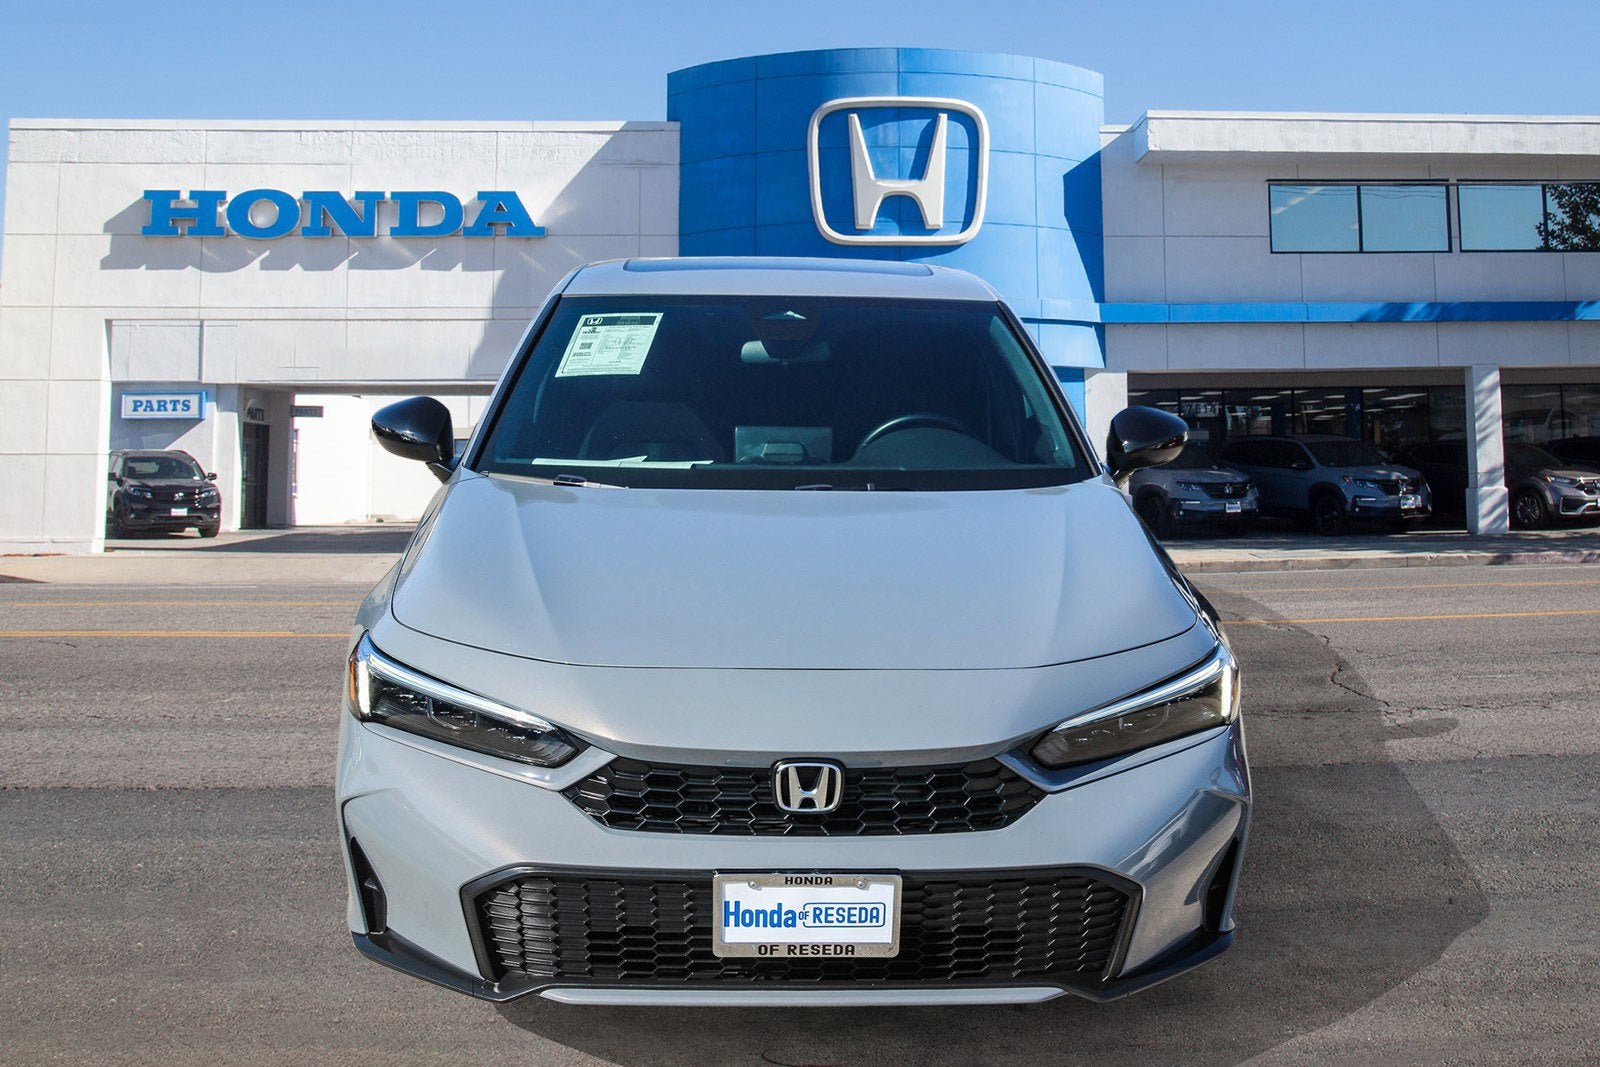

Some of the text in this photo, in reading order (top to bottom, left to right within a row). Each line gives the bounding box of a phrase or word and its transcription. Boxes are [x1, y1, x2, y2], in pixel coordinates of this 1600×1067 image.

[141, 188, 546, 240] HONDA
[131, 399, 192, 413] PARTS
[784, 876, 834, 886] HONDA
[723, 900, 880, 928] Honda OF RESEDA
[758, 944, 856, 956] OF RESEDA
